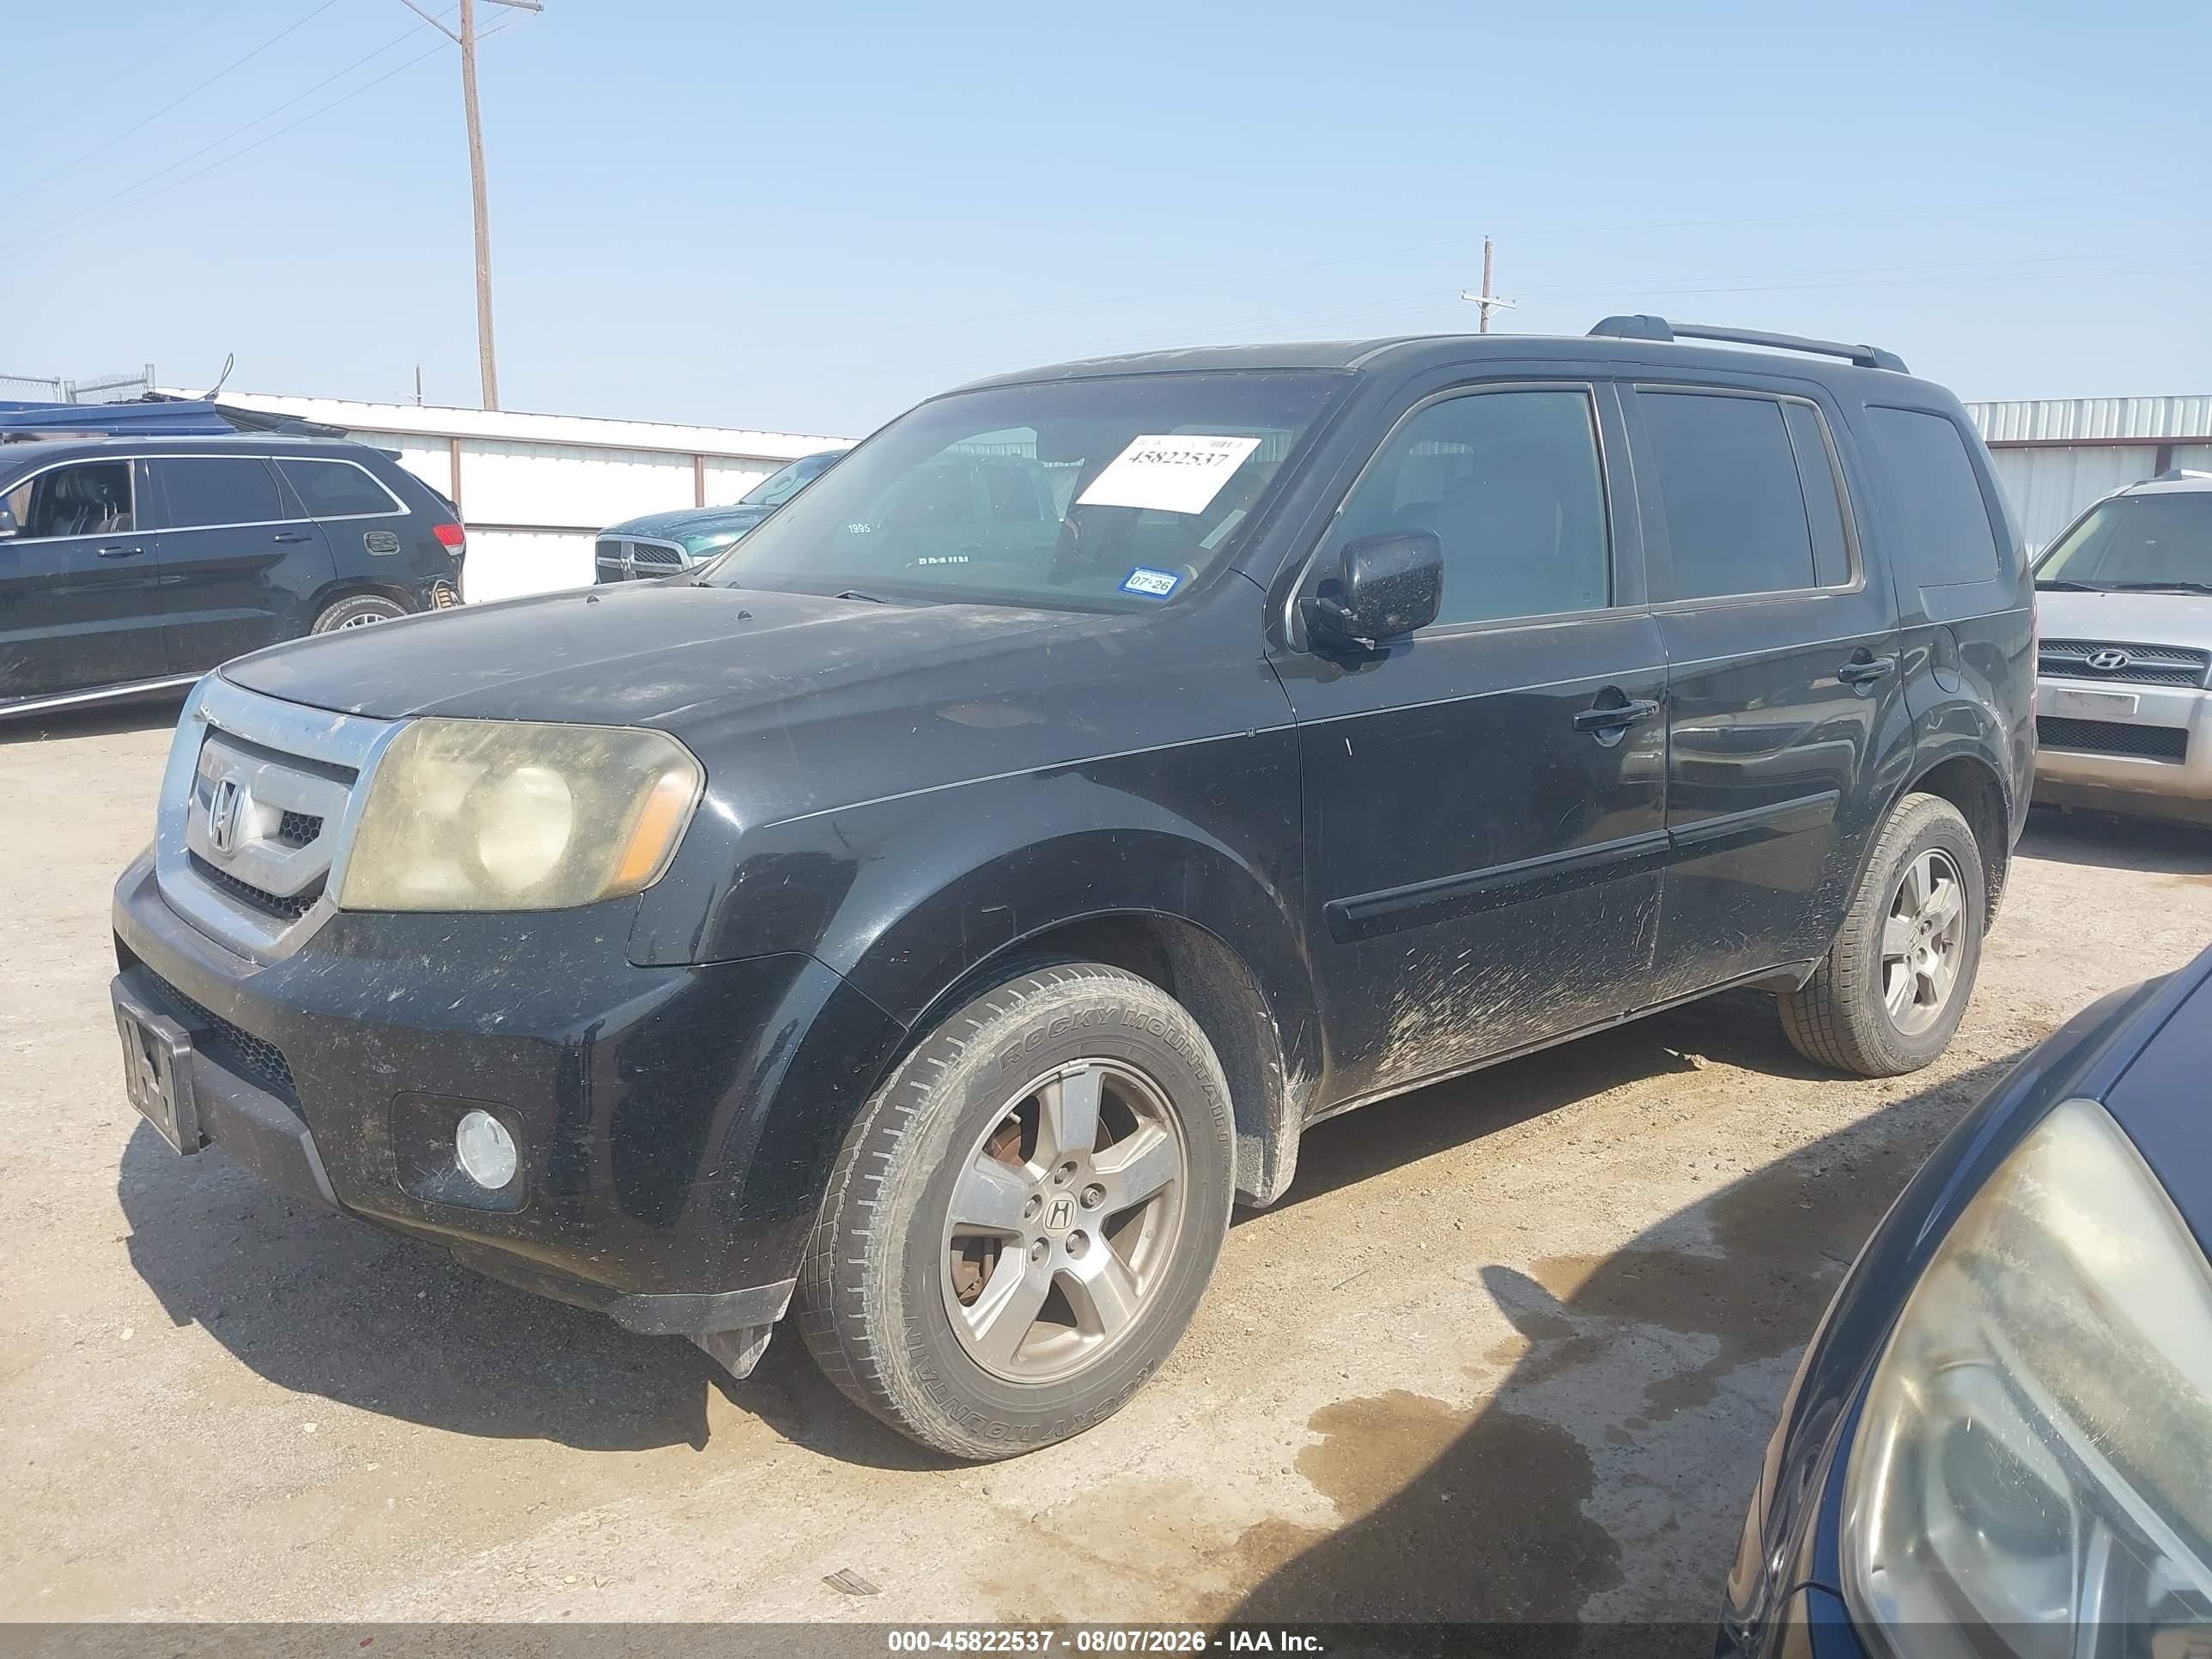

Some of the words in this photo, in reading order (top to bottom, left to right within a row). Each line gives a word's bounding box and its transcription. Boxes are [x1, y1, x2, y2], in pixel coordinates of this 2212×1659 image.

[1128, 451, 1230, 467] 45822537
[999, 1007, 1117, 1073] ROCKY
[1119, 1009, 1229, 1143] MOUNTAIN
[901, 1314, 1040, 1443] MOUNTAIN
